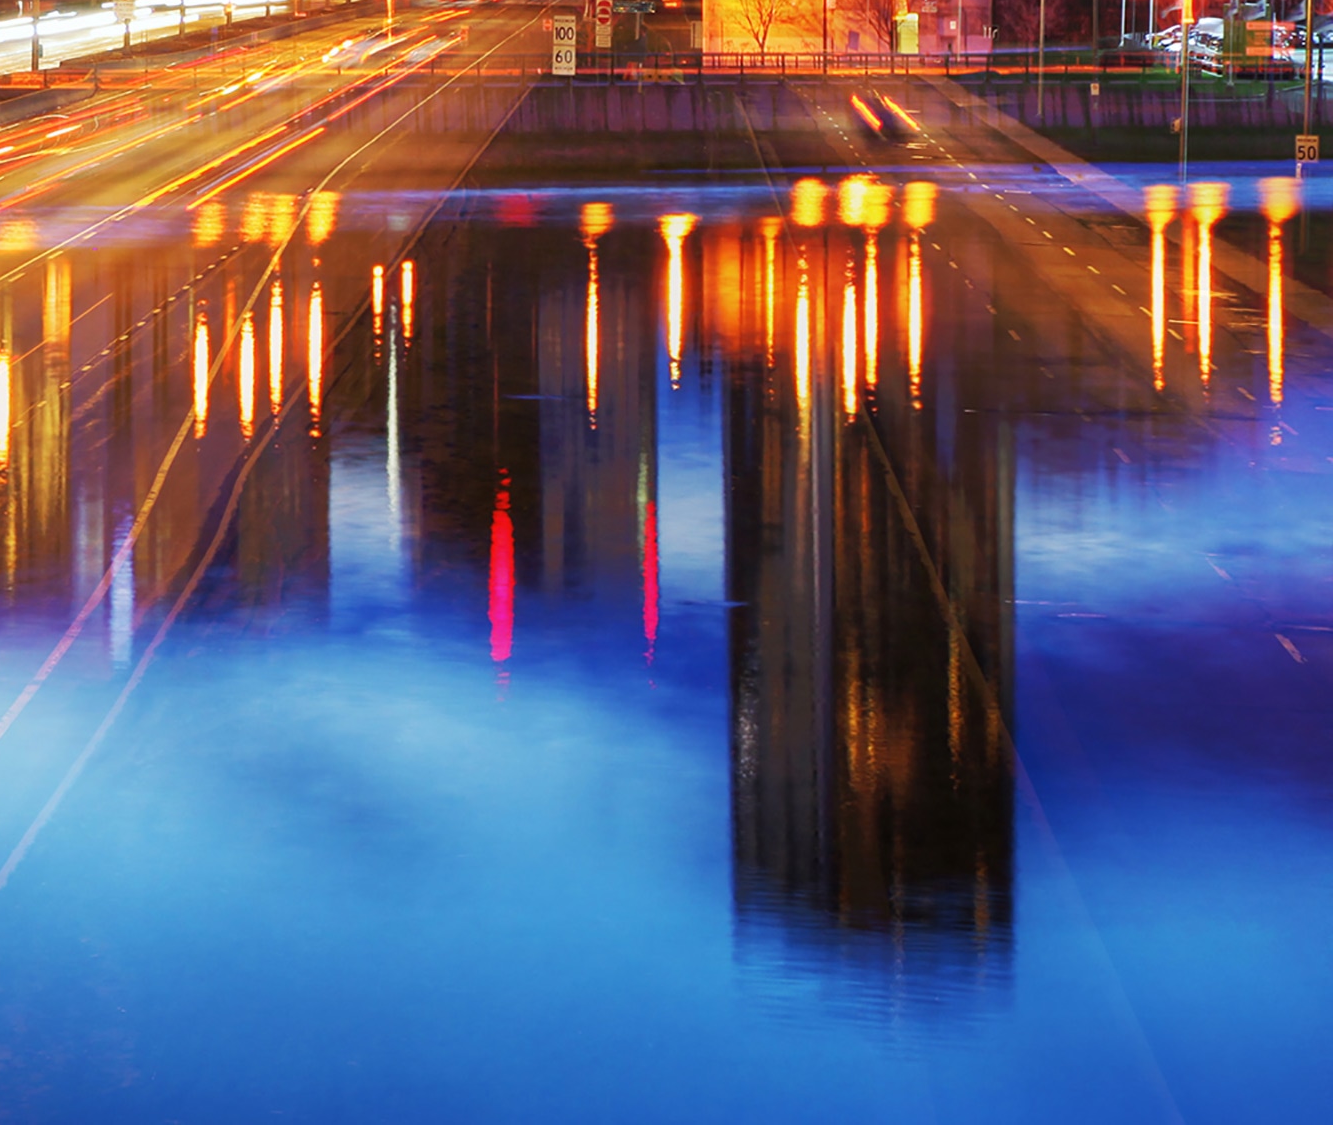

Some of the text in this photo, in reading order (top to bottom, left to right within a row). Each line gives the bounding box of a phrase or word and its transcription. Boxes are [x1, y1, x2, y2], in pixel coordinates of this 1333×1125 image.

[555, 26, 575, 41] 100
[555, 50, 573, 64] 60
[1298, 145, 1317, 161] 50
